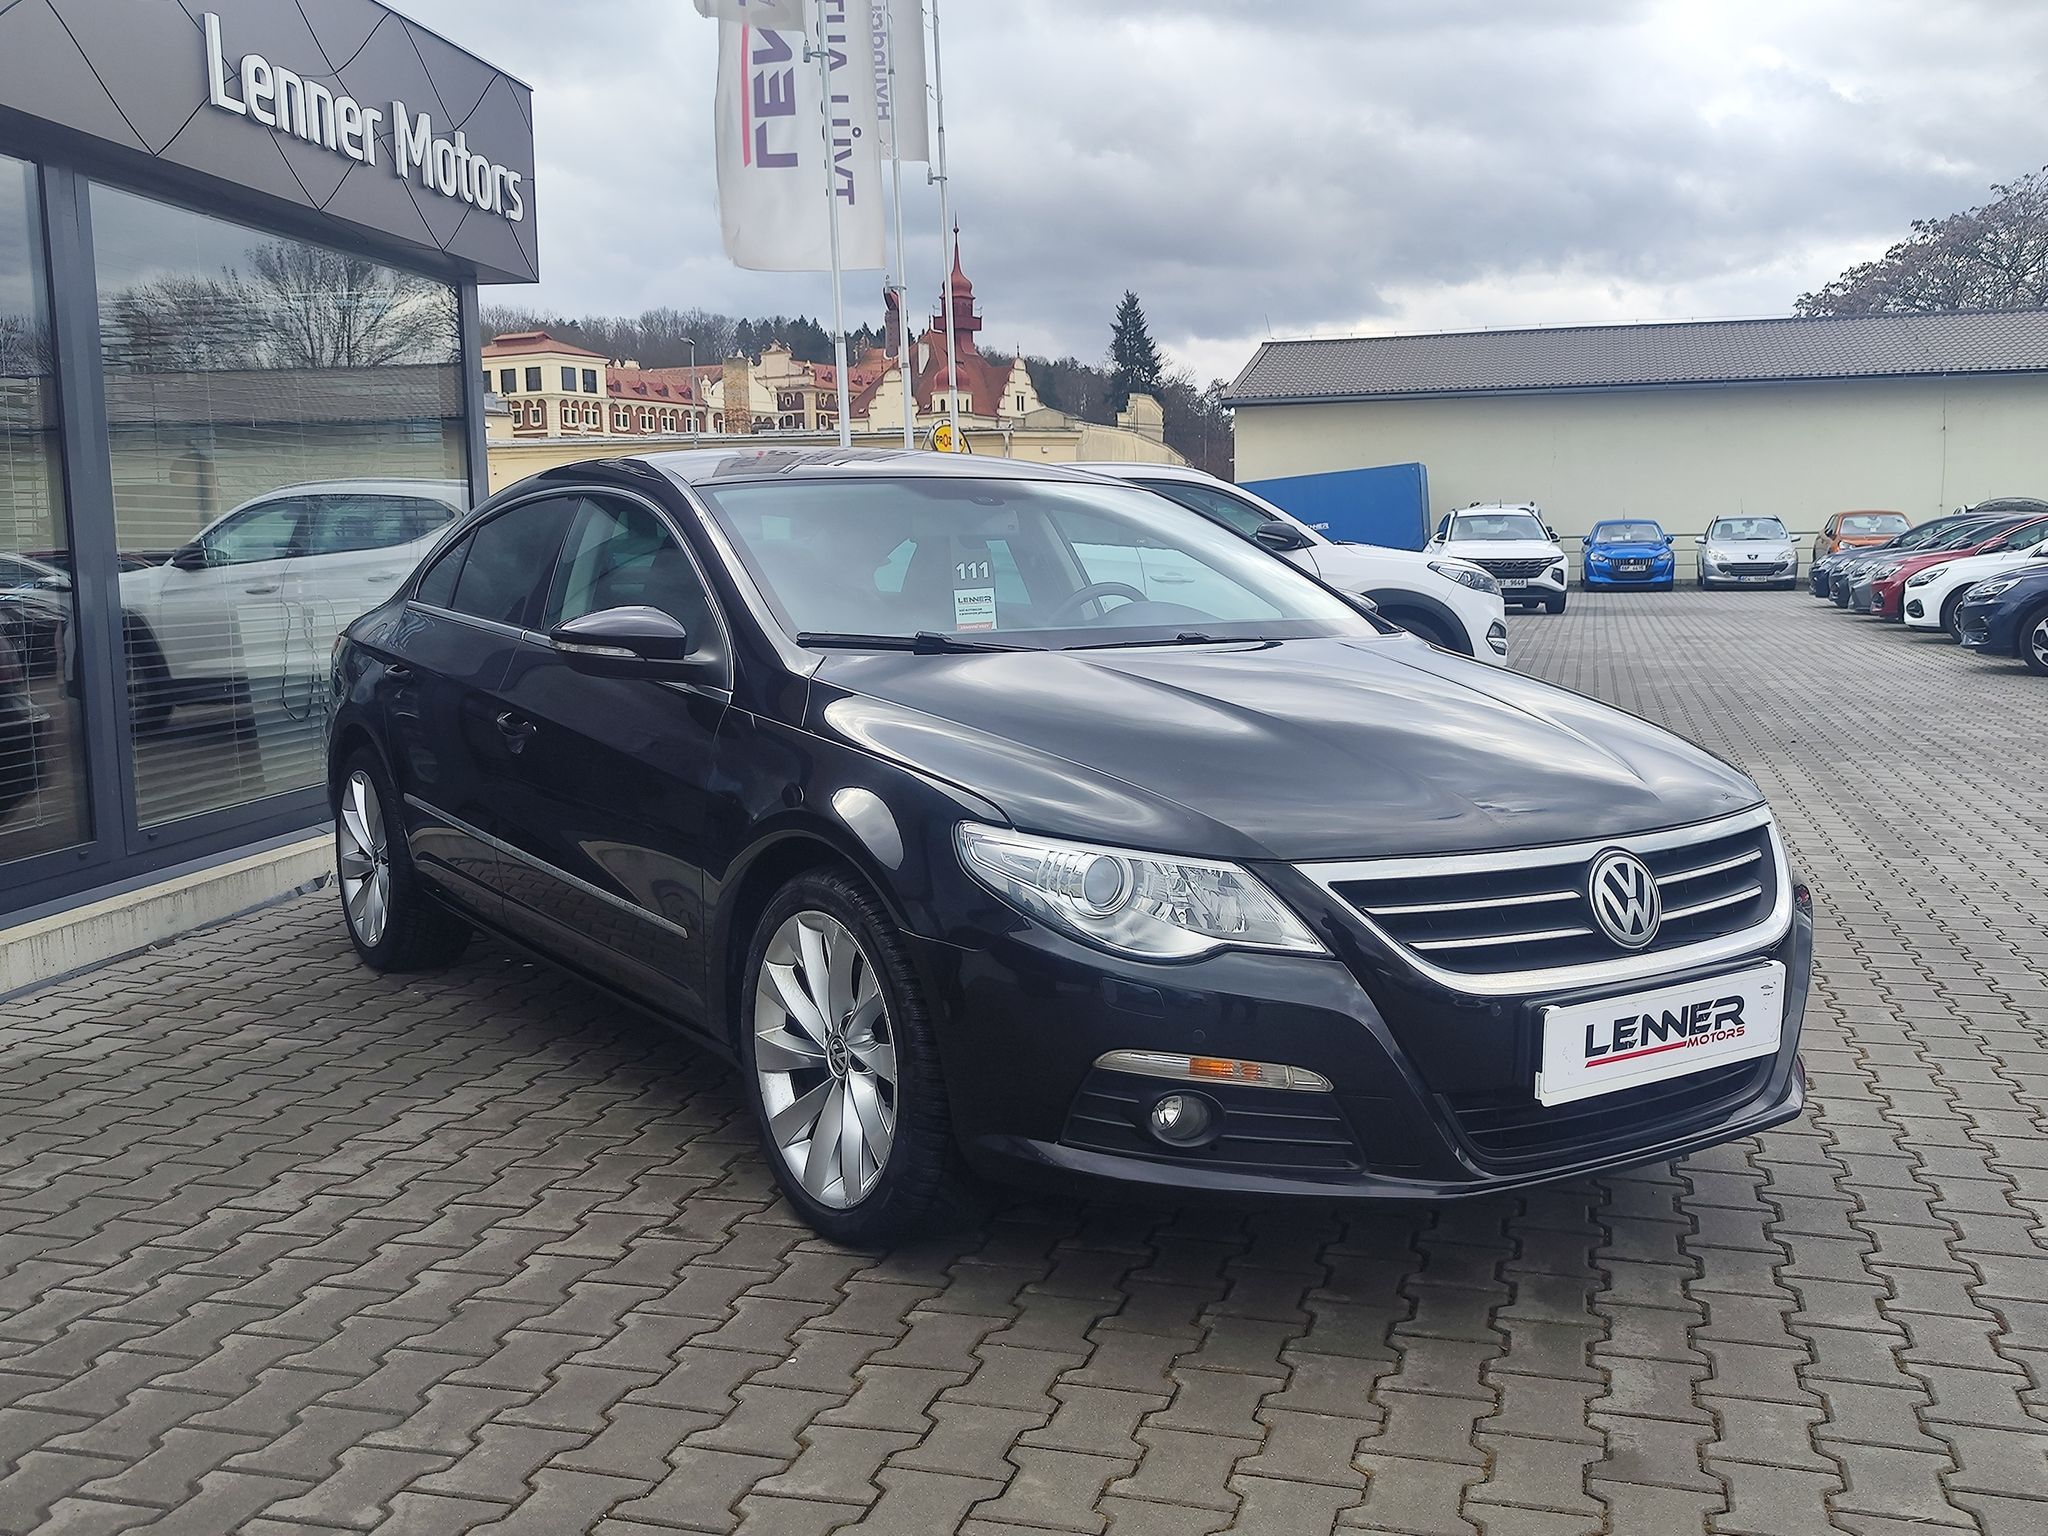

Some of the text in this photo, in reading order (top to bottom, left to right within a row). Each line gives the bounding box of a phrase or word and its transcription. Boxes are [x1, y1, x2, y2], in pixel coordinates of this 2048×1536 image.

[203, 12, 524, 223] Lenner Motors
[956, 561, 990, 580] 111
[1585, 995, 1745, 1058] LENNER
[1686, 1025, 1745, 1048] MOTORS
